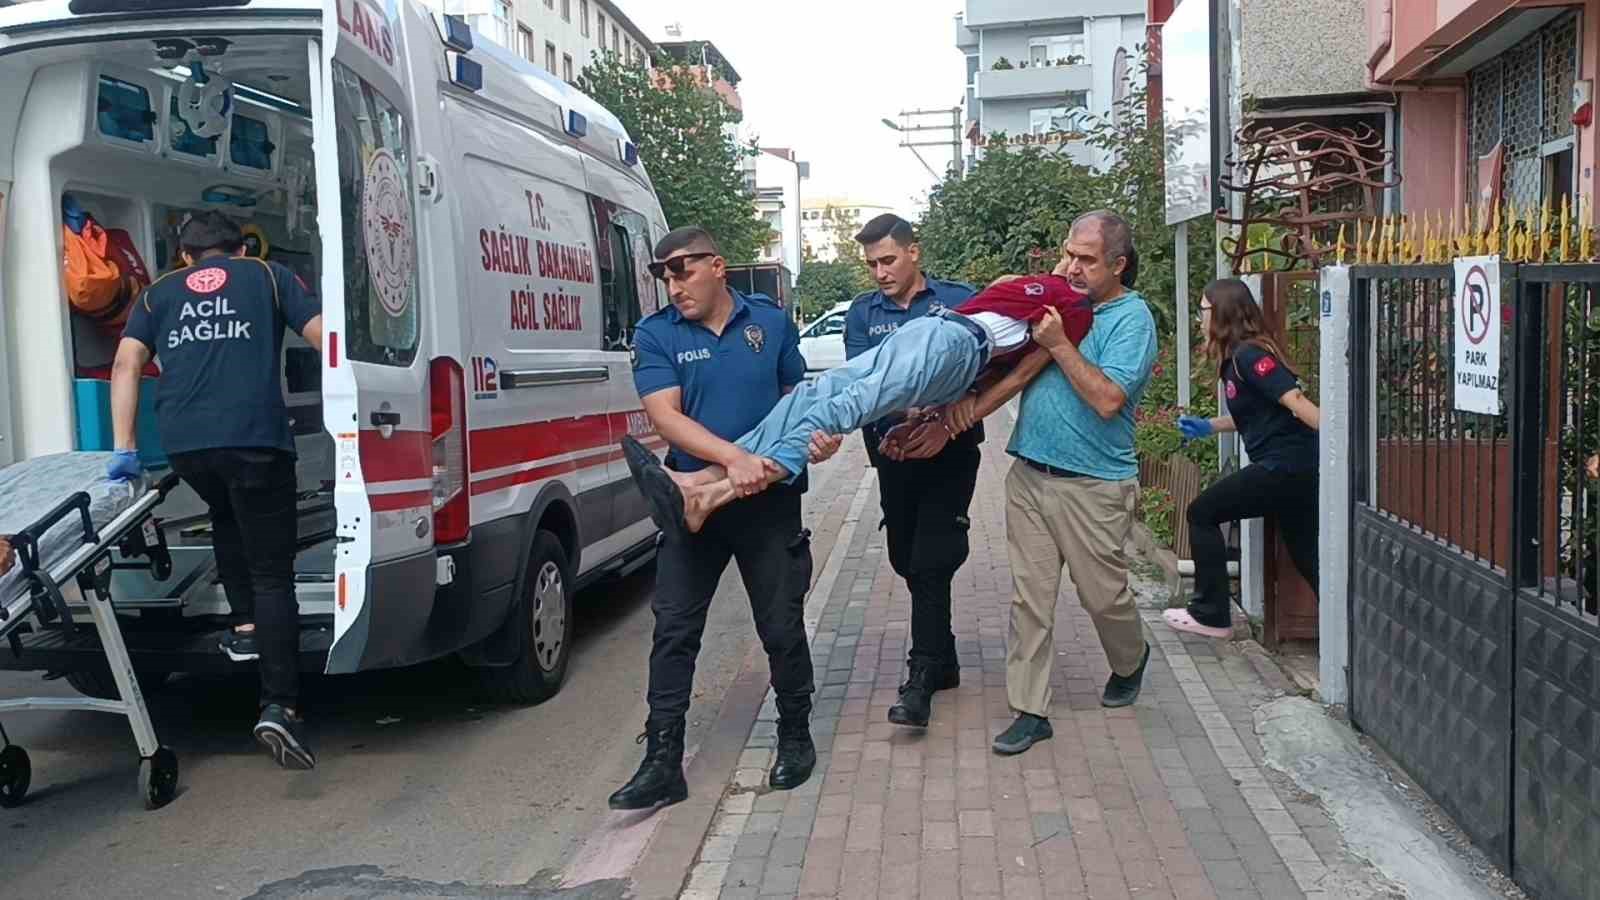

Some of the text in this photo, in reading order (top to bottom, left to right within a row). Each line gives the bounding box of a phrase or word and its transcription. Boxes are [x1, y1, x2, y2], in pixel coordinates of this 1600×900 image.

[525, 189, 550, 232] T.C.
[480, 224, 594, 284] SAĞLIK BAKANLIĞI
[179, 296, 237, 321] ACİL
[511, 284, 582, 331] ACİL SAĞLIK
[167, 319, 251, 349] SAĞLIK
[471, 356, 497, 392] 112
[1465, 350, 1488, 367] PARK
[1456, 371, 1497, 391] YAPILMAZ
